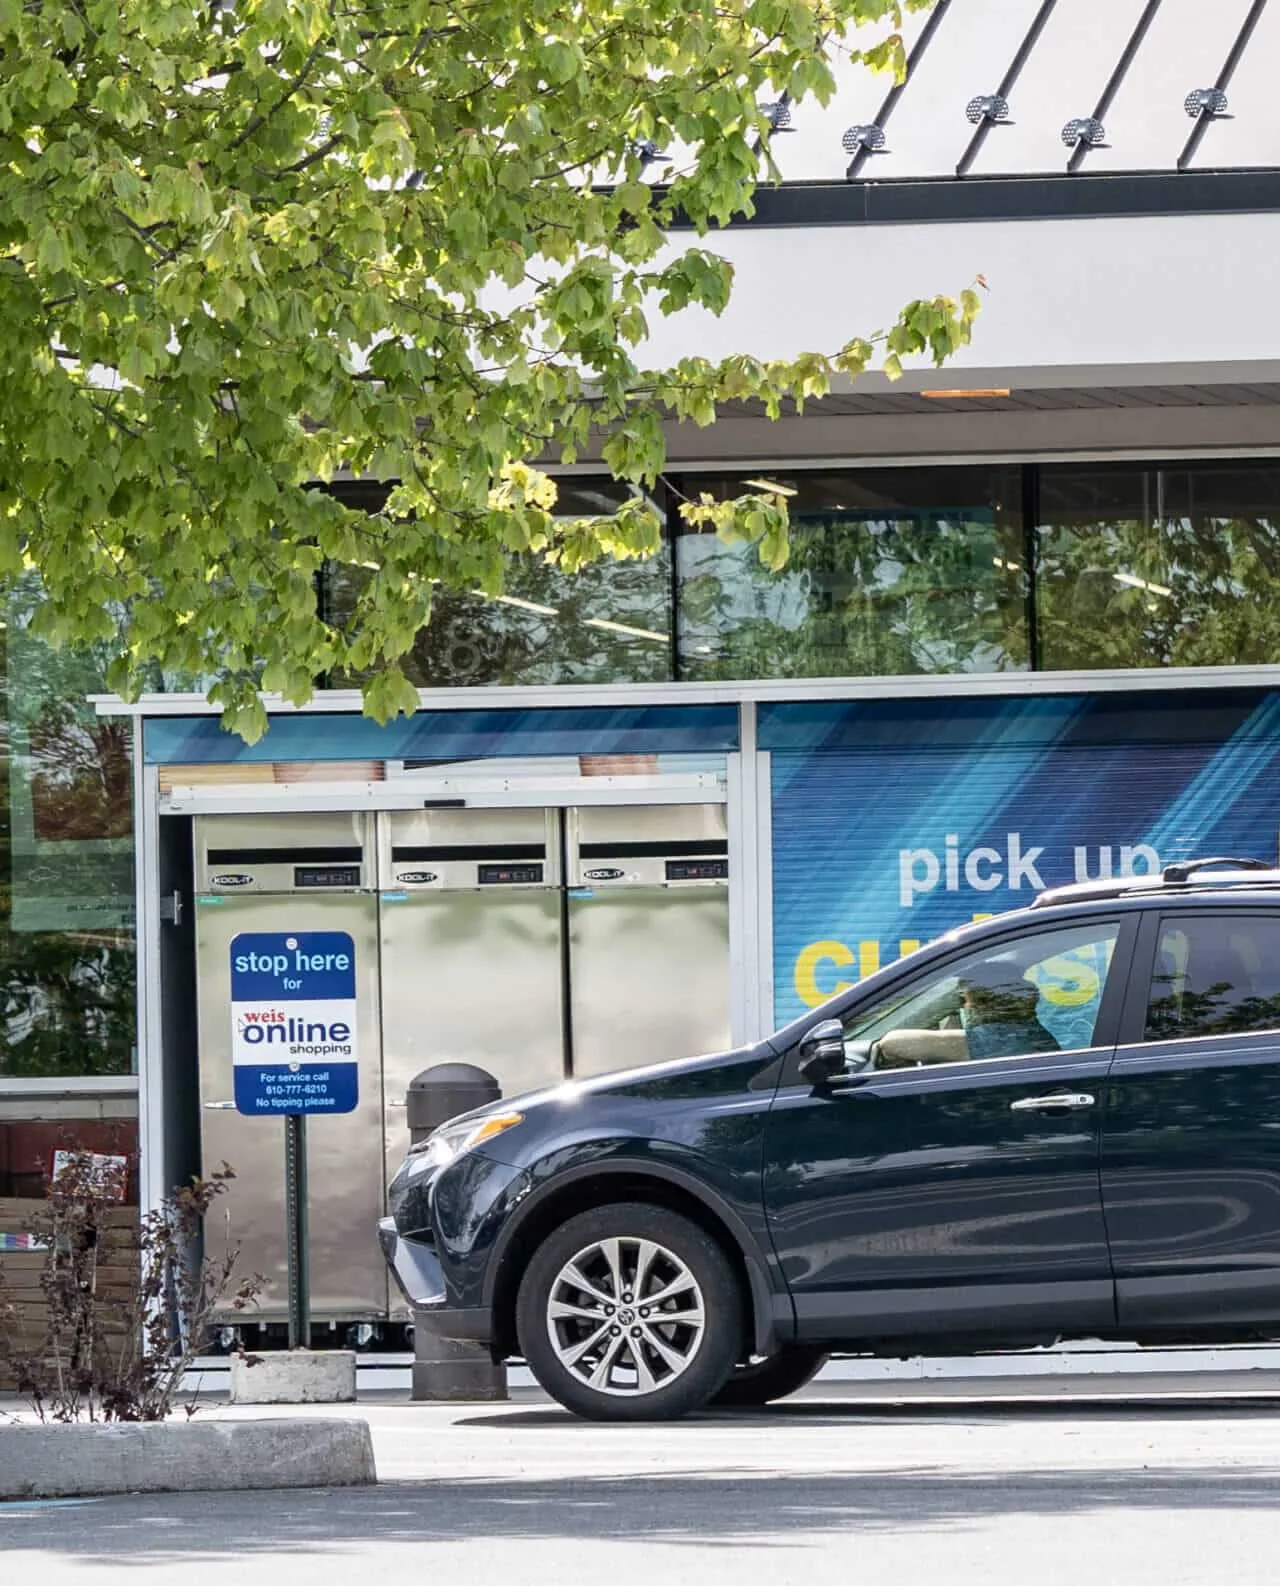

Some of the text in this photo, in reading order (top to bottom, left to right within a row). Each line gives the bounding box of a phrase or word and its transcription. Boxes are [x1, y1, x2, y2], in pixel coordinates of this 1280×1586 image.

[901, 832, 1047, 906] pick
[235, 950, 349, 976] stop here
[283, 977, 303, 990] for
[244, 1009, 285, 1022] weis
[243, 1018, 351, 1043] online
[289, 1043, 351, 1055] shopping
[260, 1072, 329, 1082] For service call
[256, 1097, 335, 1108] No tipping please
